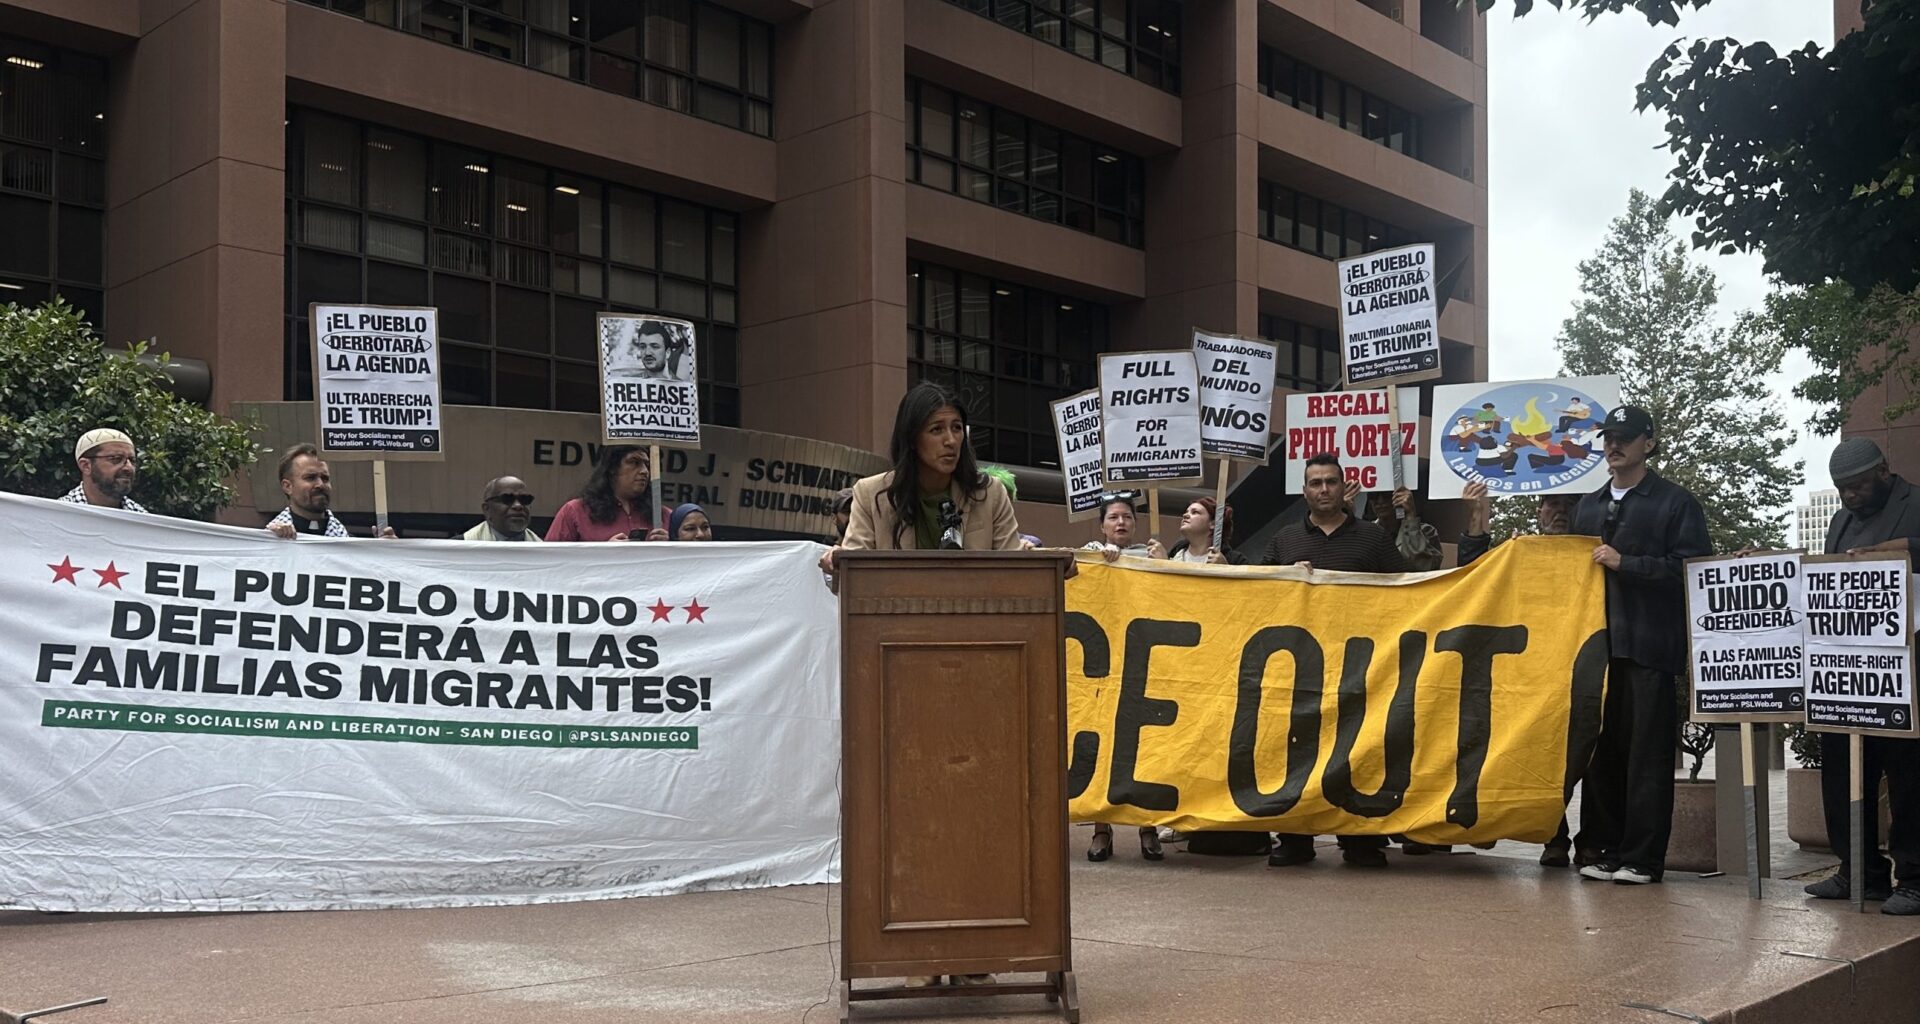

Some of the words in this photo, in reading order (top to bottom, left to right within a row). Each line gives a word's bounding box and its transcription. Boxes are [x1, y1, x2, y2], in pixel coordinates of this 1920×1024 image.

[1346, 263, 1368, 283] ¡EL
[1371, 251, 1426, 275] PUEBLO
[1349, 267, 1425, 297] DERROTARÁ
[1347, 299, 1366, 316] LA
[1369, 286, 1430, 312] AGENDA
[326, 313, 355, 332] ¡EL
[358, 314, 427, 333] PUEBLO
[1348, 319, 1432, 344] MULTIMILLONARIA
[330, 335, 425, 354] DERROTARÁ
[1196, 339, 1273, 360] TRABAJADORES
[1349, 344, 1370, 361] DE
[1372, 331, 1432, 356] TRUMP!
[326, 354, 351, 372] LA
[355, 355, 431, 374] AGENDA
[1122, 361, 1176, 379] FULL
[1211, 358, 1251, 376] DEL
[613, 383, 690, 406] RELEASE
[1199, 375, 1262, 395] MUNDO
[326, 392, 433, 406] ULTRADERECHA
[1110, 386, 1190, 407] RIGHTS
[327, 407, 354, 424] DE
[358, 407, 433, 426] TRUMP!
[613, 403, 691, 415] MAHMOUD
[1062, 404, 1079, 423] ¡EL
[615, 413, 691, 429] KHALIL!
[1136, 419, 1168, 432] FOR
[328, 432, 347, 440] Party
[358, 432, 392, 440] Socialism
[372, 440, 415, 449] PSLWeb.org
[1066, 437, 1081, 453] LA
[1137, 434, 1167, 448] ALL
[1288, 426, 1340, 460] PHIL
[1346, 422, 1416, 458] ORTZ
[698, 453, 730, 477] J.
[1110, 448, 1197, 463] IMMIGRANTS
[1344, 465, 1378, 489] RG
[1450, 456, 1514, 491] Latin@s
[1520, 480, 1542, 491] en
[1071, 476, 1088, 493] DE
[660, 482, 724, 506] ERAL
[739, 488, 833, 516] BUILDING
[1698, 568, 1726, 589] ¡EL
[1729, 561, 1796, 584] PUEBLO
[1807, 573, 1836, 591] THE
[1840, 570, 1900, 591] PEOPLE
[145, 561, 216, 601] EL
[233, 569, 458, 617] PUEBLO
[473, 588, 638, 627] UNIDO
[1707, 582, 1788, 614] UNIDO
[1807, 593, 1842, 610] WILL
[1845, 592, 1900, 610] DEFEAT
[1704, 606, 1795, 631] DEFENDERÁ
[110, 600, 485, 663] DEFENDERÁ
[499, 630, 540, 666] A
[556, 631, 659, 669] LAS
[1699, 650, 1710, 664] A
[1713, 649, 1735, 663] LAS
[1738, 645, 1802, 662] FAMILIAS
[1809, 654, 1903, 670] EXTREME-RIGHT
[35, 643, 343, 700] FAMILIAS
[359, 664, 712, 713] MIGRANTES!
[1701, 662, 1802, 682] MIGRANTES!
[1811, 670, 1903, 698] AGENDA!
[1701, 693, 1719, 702] Party
[1730, 692, 1760, 700] Socialism
[1740, 701, 1783, 709] PSLWeb.org
[1811, 703, 1827, 713] Party
[1826, 704, 1835, 712] for
[1835, 705, 1864, 714] Socialism
[1864, 707, 1877, 715] and
[54, 706, 120, 722] PARTY
[128, 711, 167, 725] FOR
[174, 713, 279, 730] SOCIALISM
[285, 719, 325, 731] AND
[331, 721, 440, 737] LIBERATION
[460, 727, 495, 740] SAN
[500, 728, 554, 742] DIEGO
[568, 730, 690, 743] @PSLSANDIEGO
[1066, 611, 1202, 812] CE
[1227, 624, 1529, 830] OUT
[1811, 713, 1840, 721] Liberation
[1846, 714, 1886, 726] PSLWeb.org
